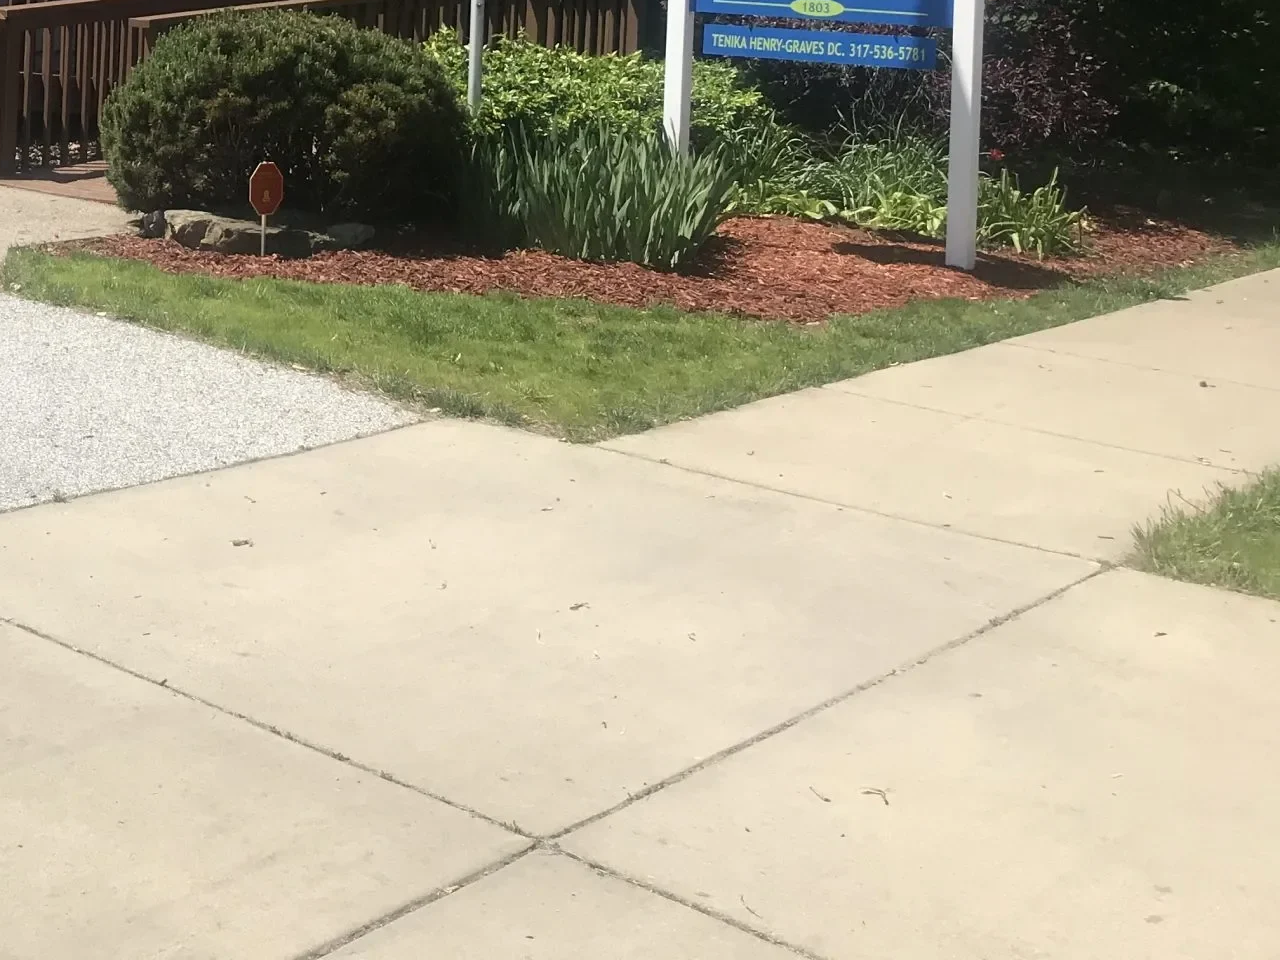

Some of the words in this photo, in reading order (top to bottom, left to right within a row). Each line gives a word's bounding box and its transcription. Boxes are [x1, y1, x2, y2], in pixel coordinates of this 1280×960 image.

[802, 2, 830, 14] 1803
[712, 34, 747, 49] TENIKA
[749, 36, 825, 55] HENRY-GRAVES
[849, 44, 926, 62] 317-536-5781
